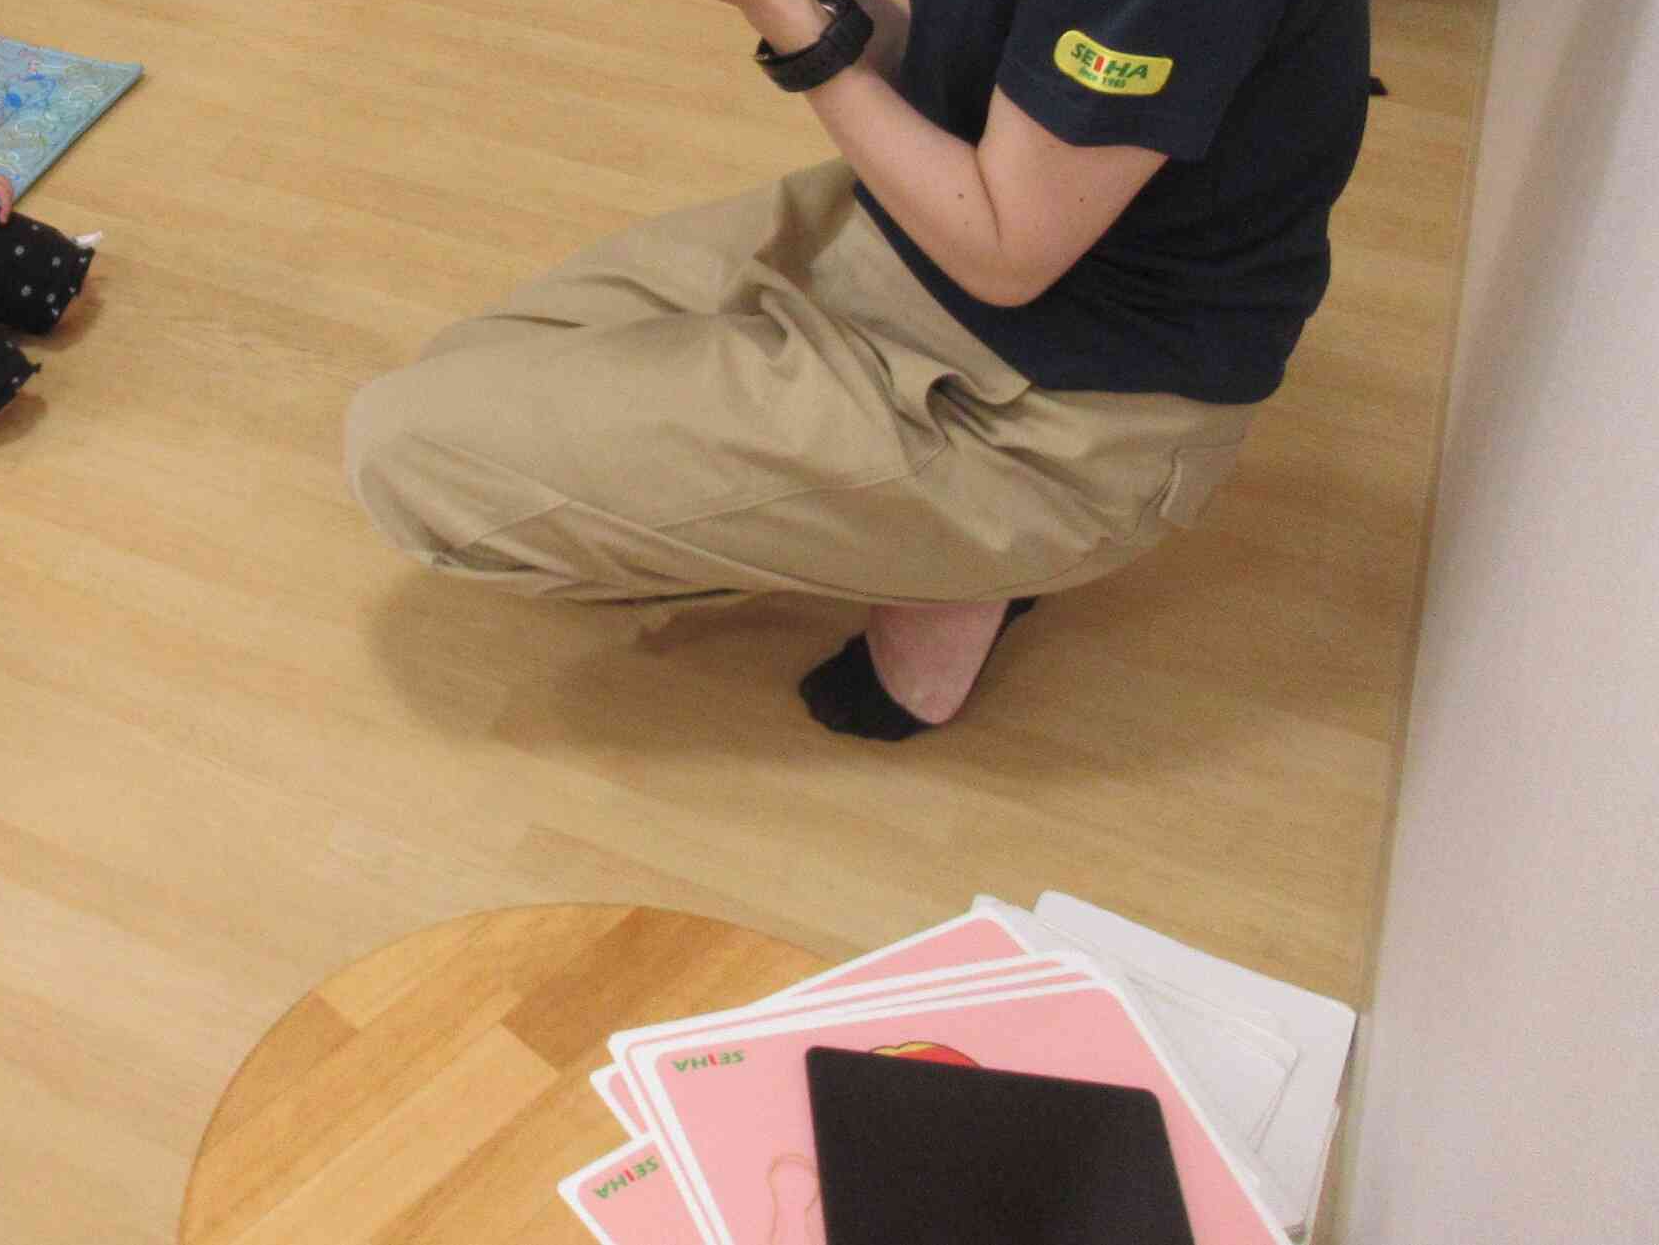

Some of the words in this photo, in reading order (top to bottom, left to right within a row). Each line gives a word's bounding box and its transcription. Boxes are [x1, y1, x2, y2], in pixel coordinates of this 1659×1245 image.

[1071, 43, 1148, 79] SEIHA
[671, 1051, 745, 1072] SEIHA
[594, 1157, 660, 1198] SEIHA
